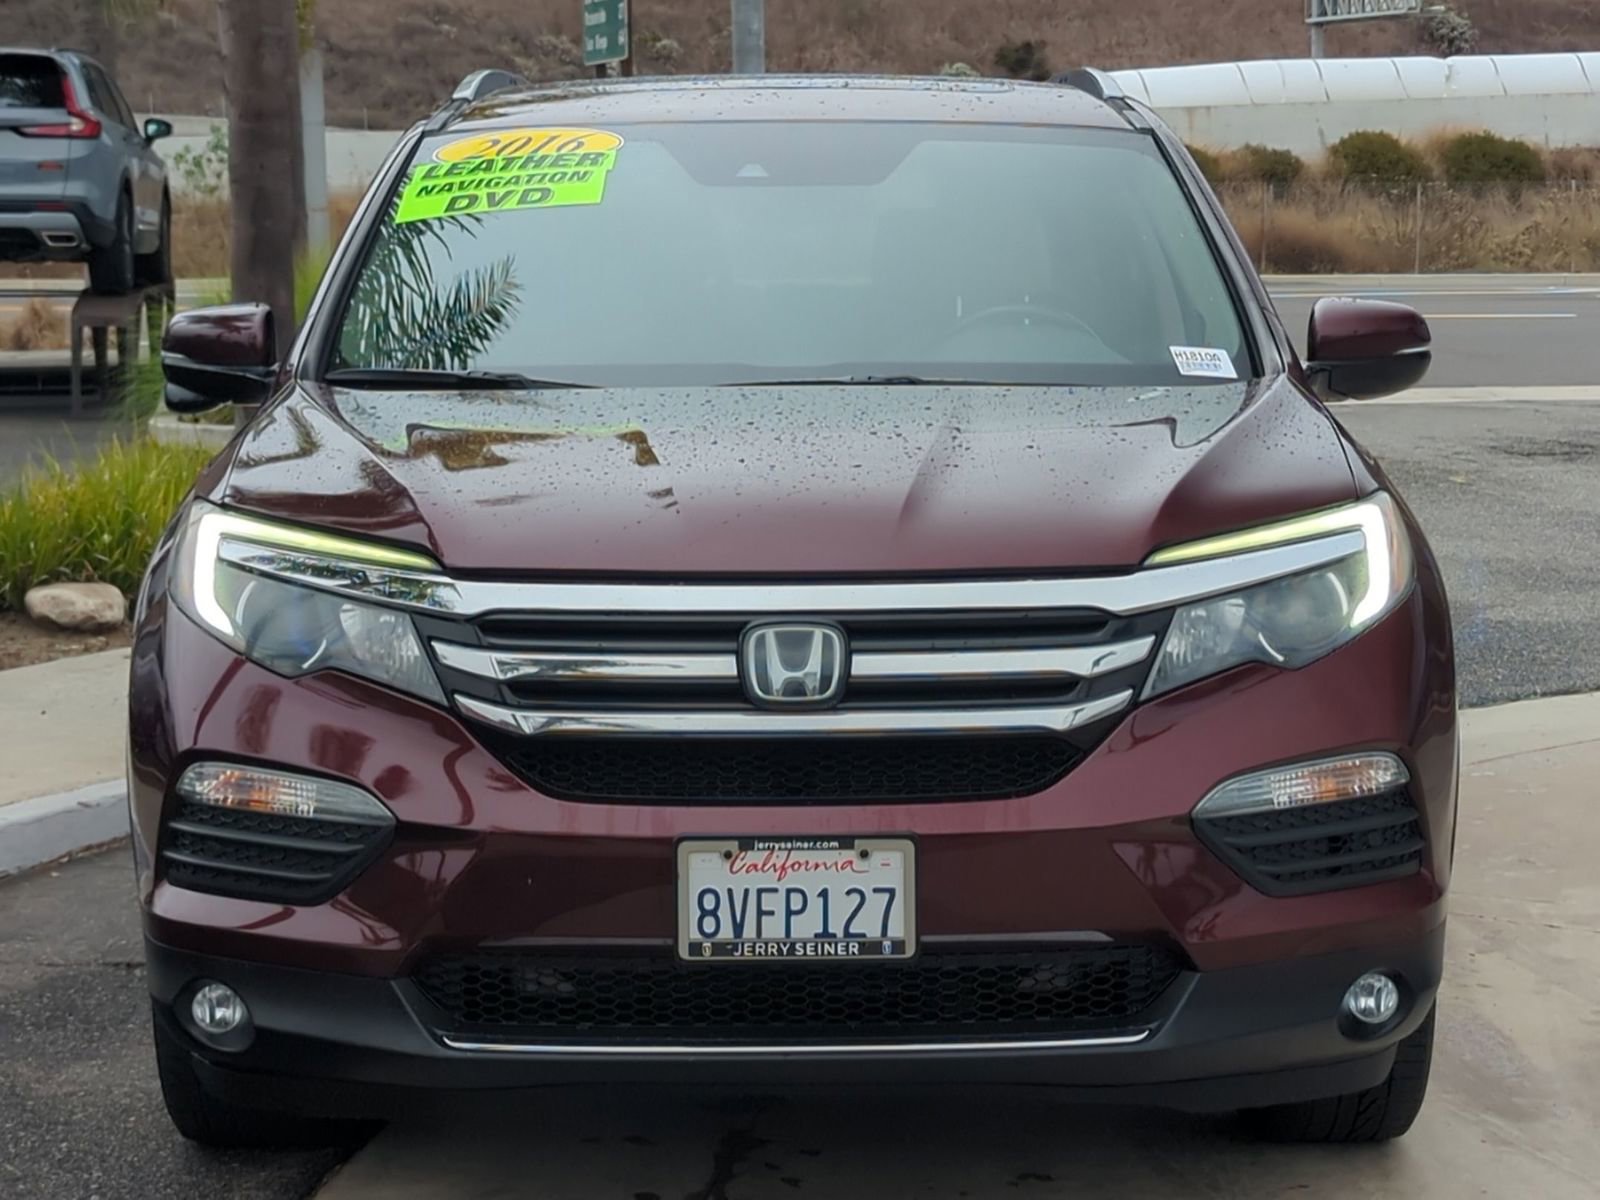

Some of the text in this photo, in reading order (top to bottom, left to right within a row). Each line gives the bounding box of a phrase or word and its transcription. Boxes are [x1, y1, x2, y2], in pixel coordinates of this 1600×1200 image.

[463, 134, 588, 160] 2016
[421, 151, 607, 181] LEATHER
[416, 170, 592, 198] NAVIGATION
[444, 187, 554, 214] DVD
[754, 840, 839, 851] jerryseiner.com
[728, 849, 869, 882] California
[697, 887, 896, 939] 8VFP127
[732, 942, 859, 956] JERRY SEINER
